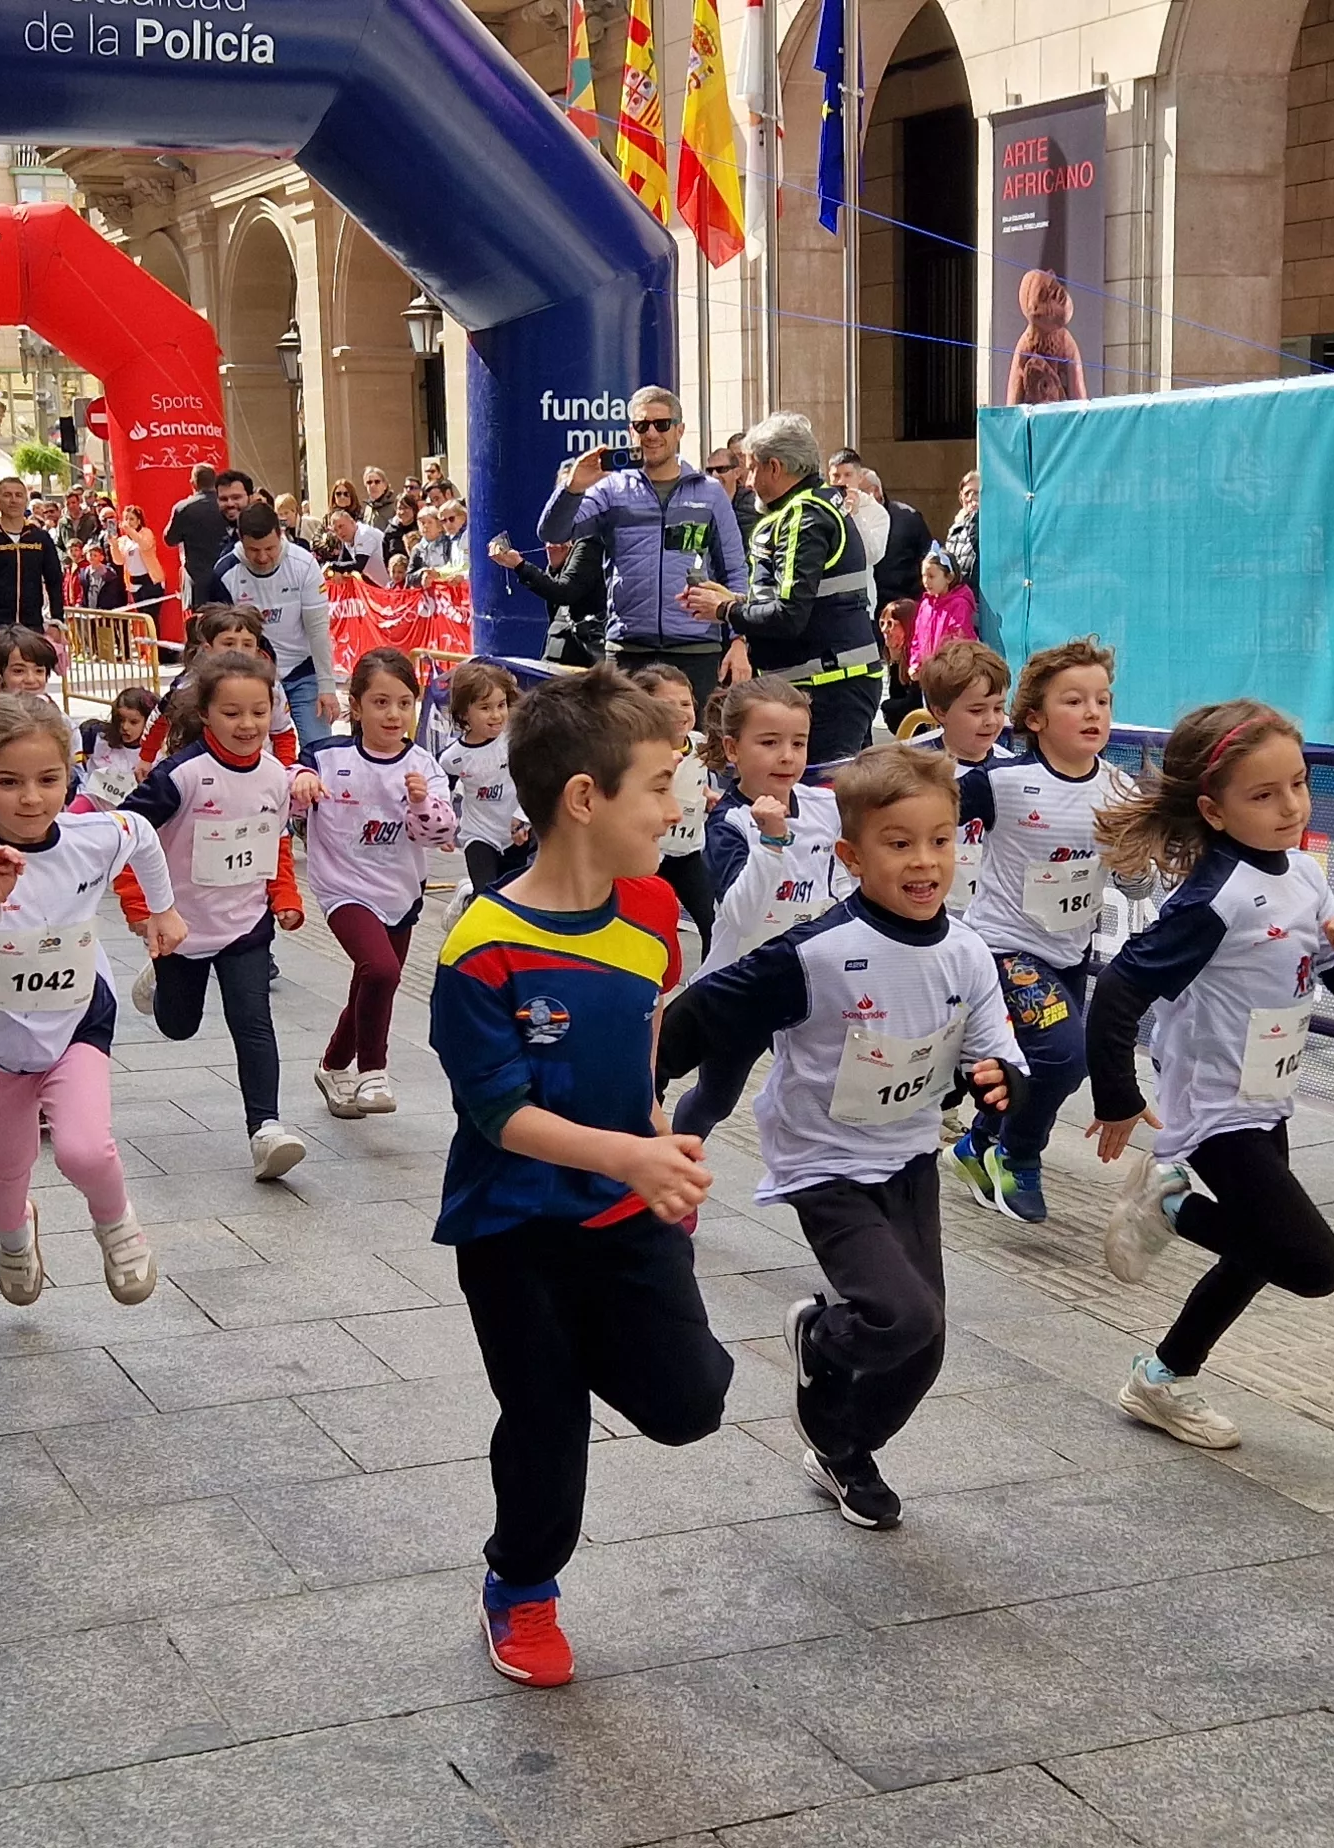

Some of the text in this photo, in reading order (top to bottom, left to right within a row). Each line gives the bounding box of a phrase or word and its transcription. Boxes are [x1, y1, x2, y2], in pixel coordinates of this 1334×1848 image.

[24, 11, 274, 64] de la Policía
[1003, 136, 1048, 168] ARTE
[1003, 161, 1094, 200] AFRICANO
[151, 393, 203, 412] Sports
[540, 389, 634, 421] funda
[149, 420, 223, 438] Santander
[102, 781, 126, 798] 1004
[224, 850, 253, 870] 113
[11, 968, 76, 993] 1042
[842, 1009, 888, 1021] Santander
[856, 1053, 894, 1068] Santander
